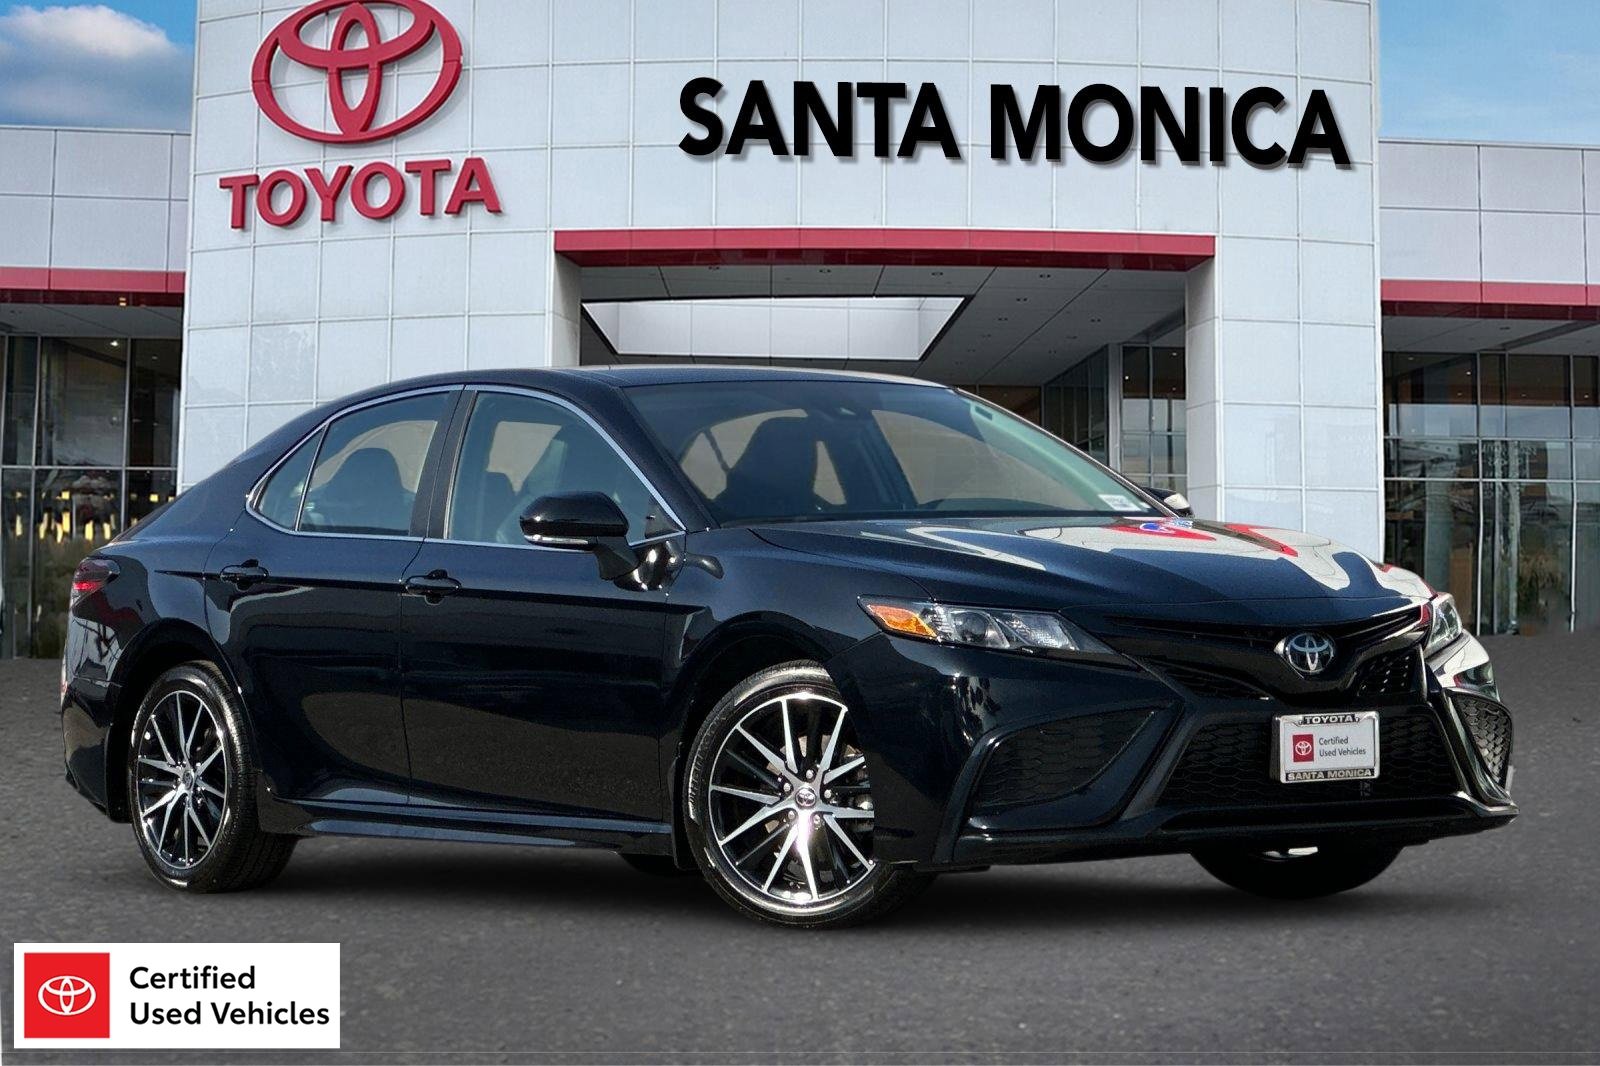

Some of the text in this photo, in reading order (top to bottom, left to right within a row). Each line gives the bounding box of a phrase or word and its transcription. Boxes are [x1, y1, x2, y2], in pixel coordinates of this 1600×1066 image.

[678, 77, 1351, 168] SANTA MONICA
[219, 157, 502, 230] TOYOTA
[1305, 715, 1354, 724] TOYOTA
[1318, 736, 1349, 746] Certified
[1318, 748, 1366, 757] Used Vehicles
[1287, 769, 1372, 780] SANTA MONICA
